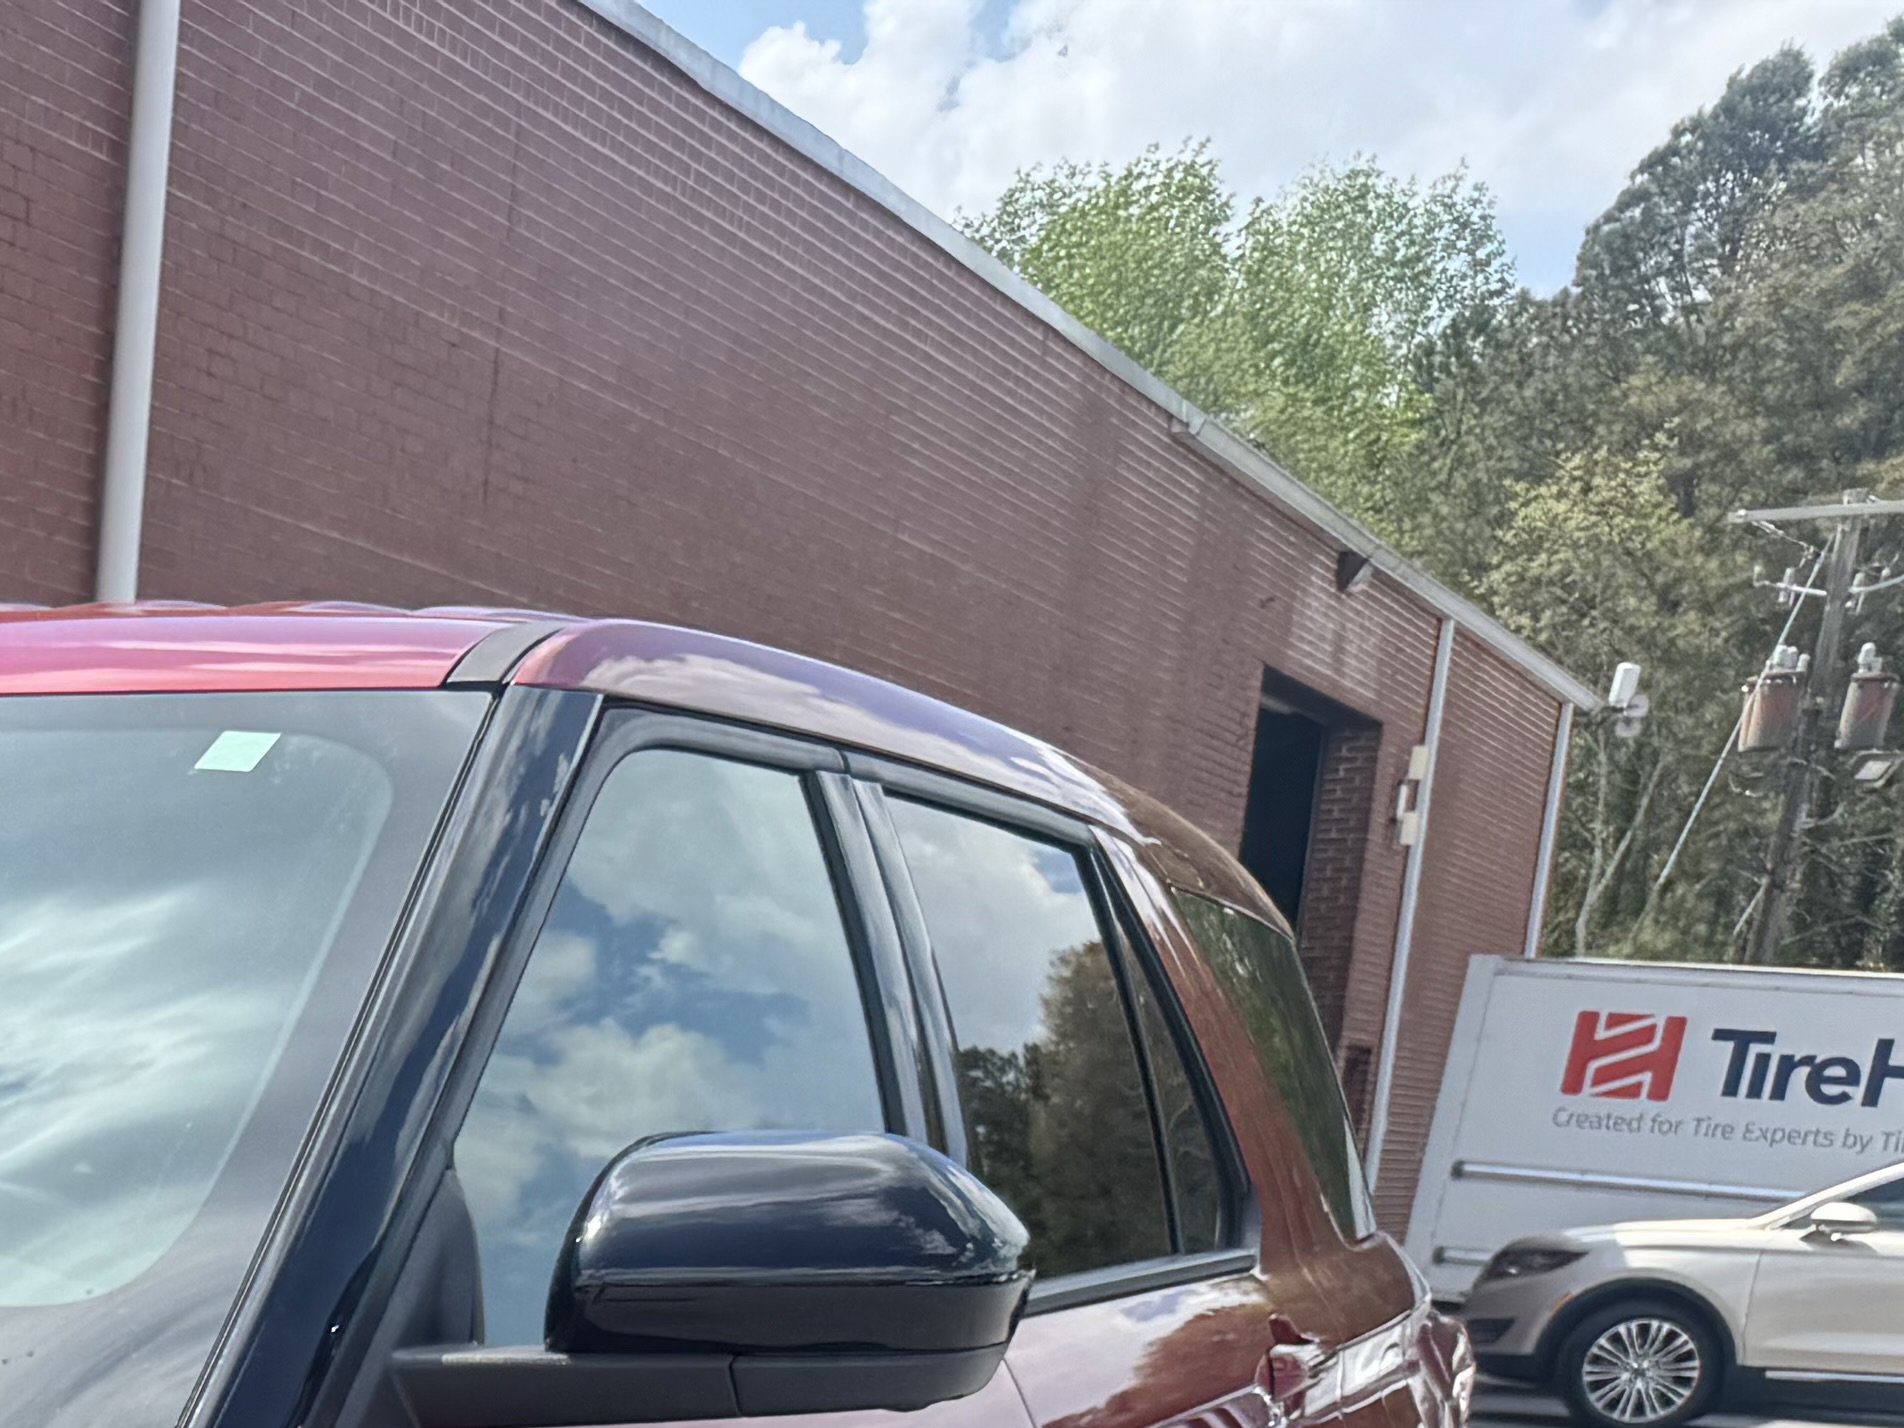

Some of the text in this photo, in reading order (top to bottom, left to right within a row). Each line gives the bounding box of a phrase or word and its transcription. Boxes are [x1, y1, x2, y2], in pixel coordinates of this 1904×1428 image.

[1552, 1106, 1644, 1134] Created
[1650, 1112, 1684, 1136] for
[1692, 1115, 1735, 1141] Tire
[1743, 1121, 1835, 1148] Experts
[1838, 1127, 1874, 1154] by
